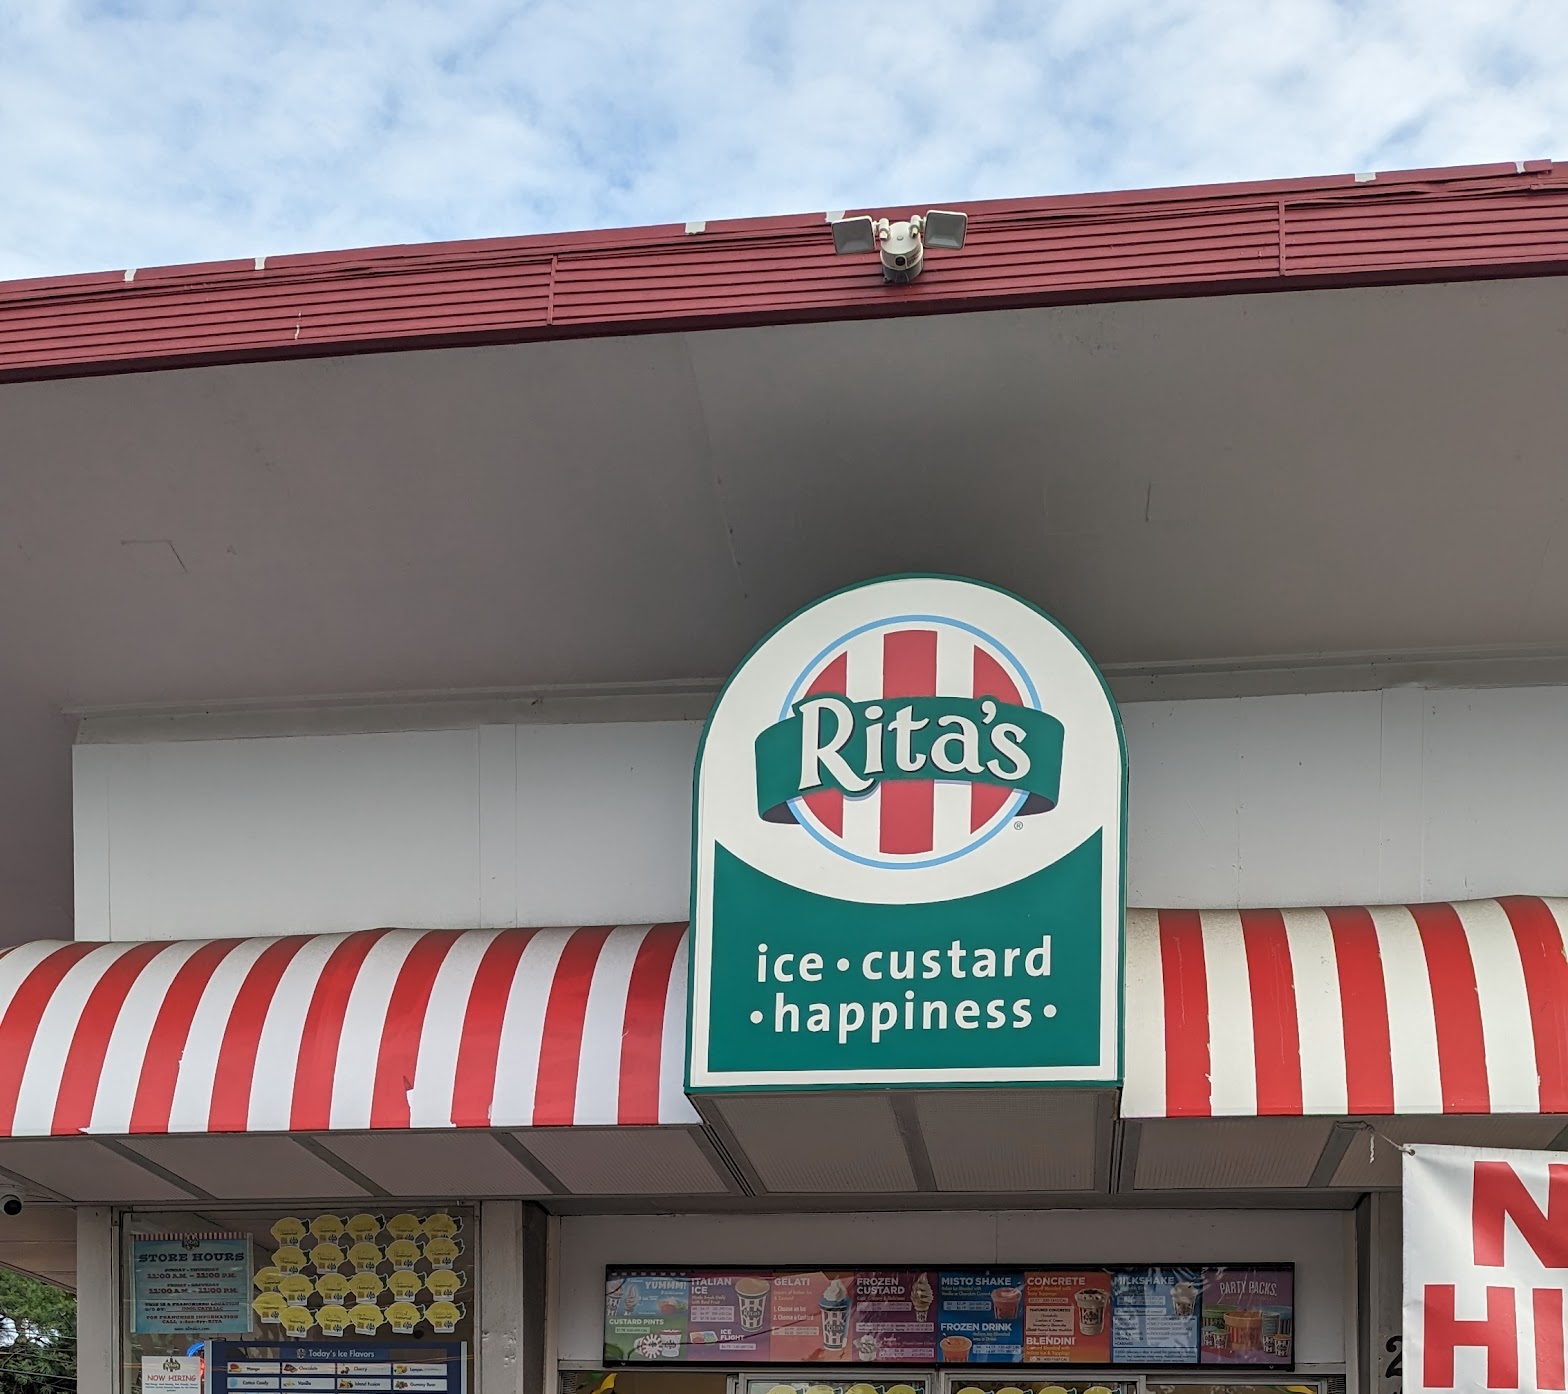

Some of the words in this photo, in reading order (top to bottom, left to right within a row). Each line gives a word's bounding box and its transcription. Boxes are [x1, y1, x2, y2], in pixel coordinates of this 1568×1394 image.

[796, 696, 1032, 793] Rita's
[757, 943, 823, 983] ice
[862, 935, 1053, 982] custard
[774, 990, 1033, 1044] happiness
[138, 1253, 188, 1262] STORE
[192, 1252, 245, 1262] HOURS
[691, 1278, 732, 1286] ITALIAN
[774, 1278, 810, 1286] GELATI
[856, 1278, 899, 1286] FROZEN
[941, 1277, 974, 1286] MISTO
[975, 1277, 1012, 1286] SHAKE
[1027, 1277, 1086, 1285] CONCRETE
[1113, 1276, 1175, 1285] MILKSHAKE
[645, 1281, 687, 1290] YUMMM!
[1219, 1280, 1247, 1295] PARTY
[691, 1286, 708, 1295] ICE
[856, 1286, 905, 1295] CUSTARD
[940, 1323, 980, 1331] FROZEN
[981, 1323, 1012, 1331] DRINK
[309, 1349, 337, 1359] Today's
[337, 1350, 349, 1358] Ice
[350, 1349, 375, 1358] Flavors
